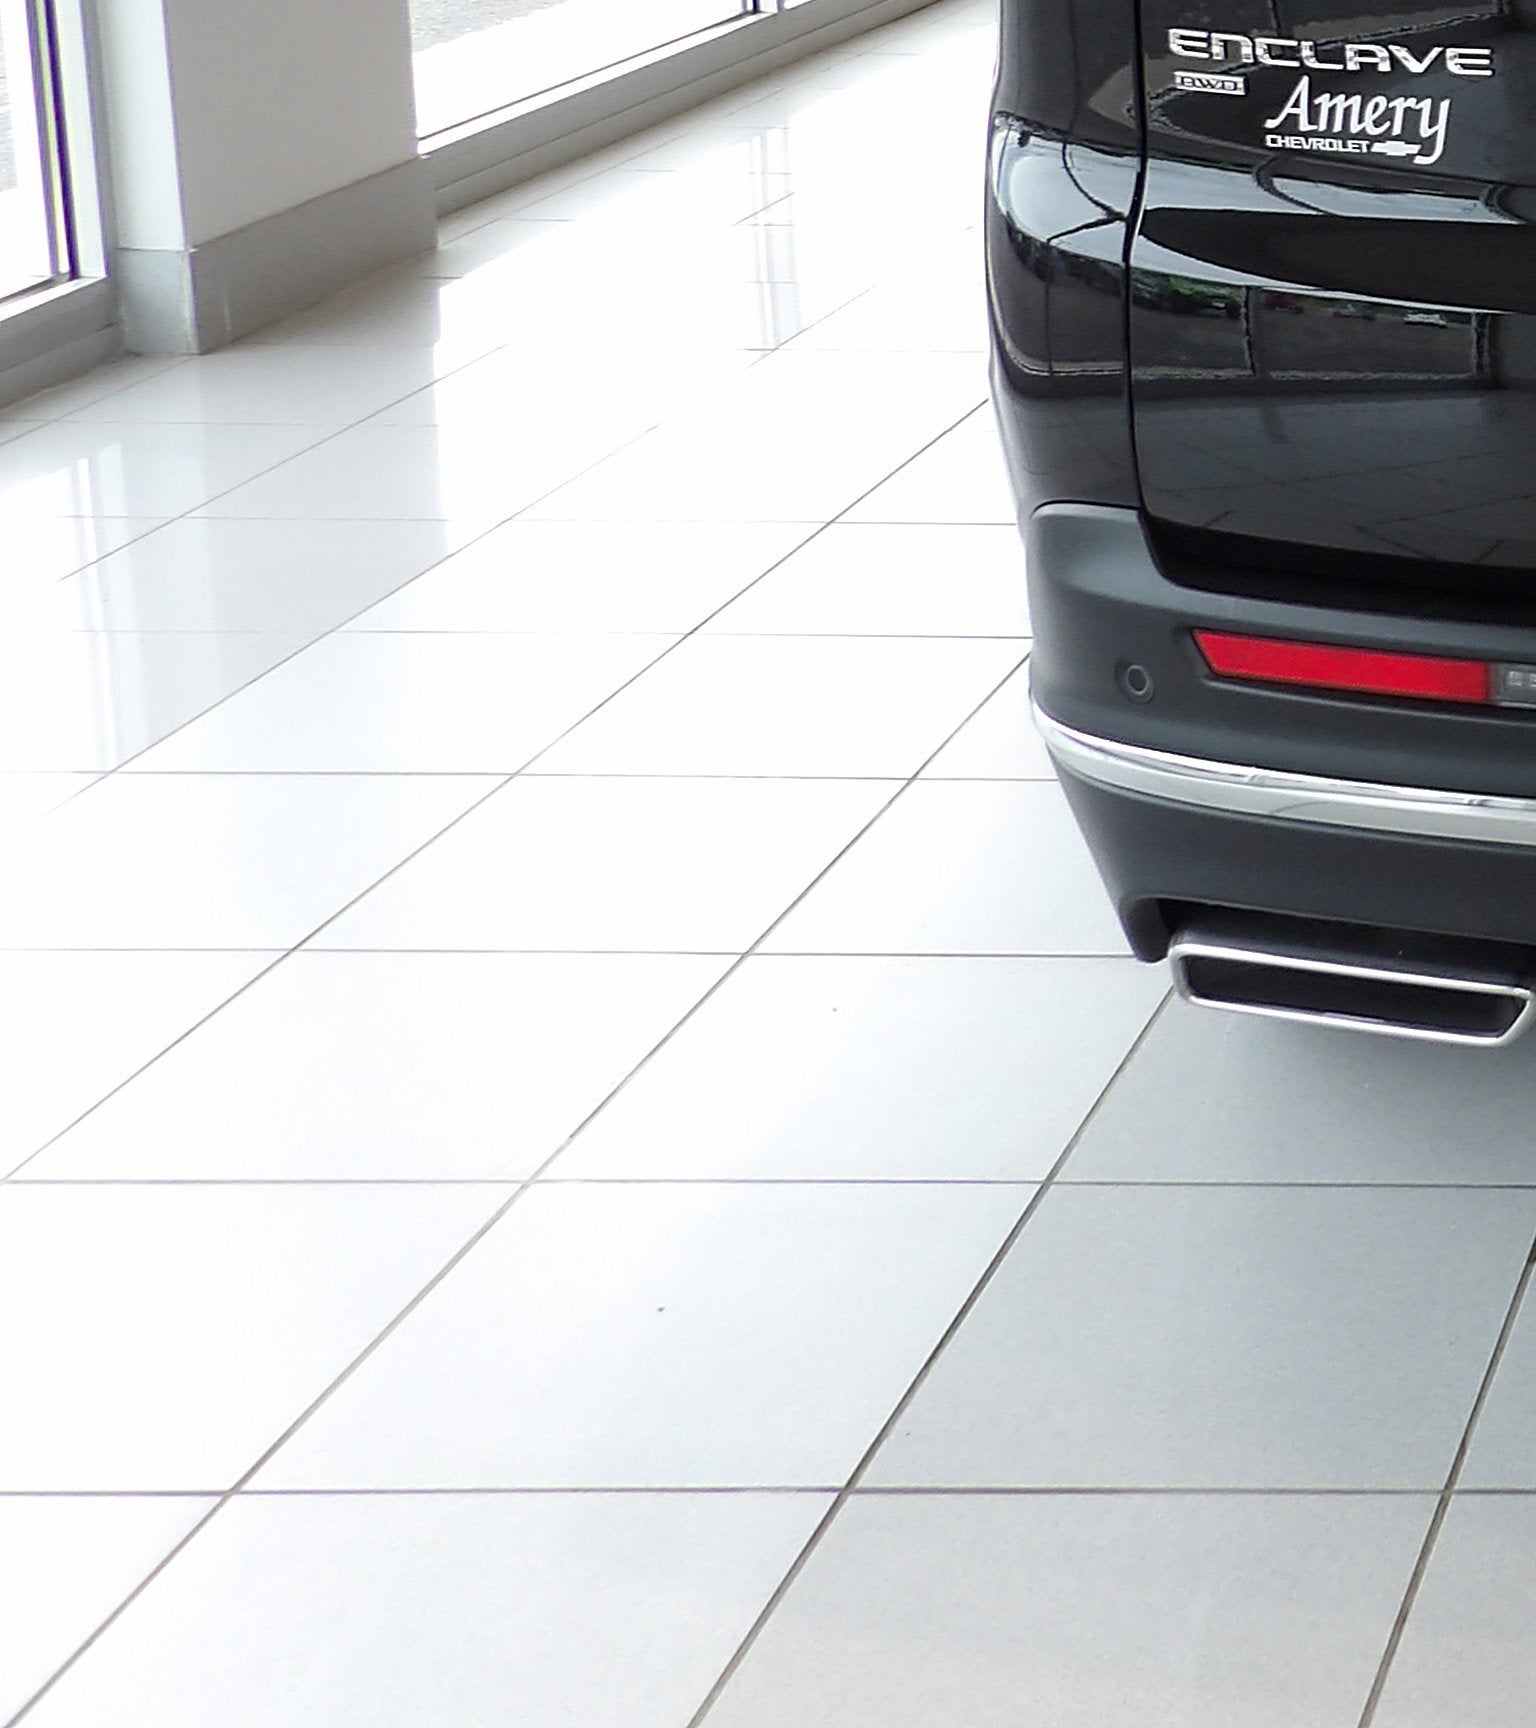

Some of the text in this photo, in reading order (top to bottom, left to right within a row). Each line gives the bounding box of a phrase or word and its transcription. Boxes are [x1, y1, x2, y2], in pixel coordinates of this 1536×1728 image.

[1167, 27, 1495, 76] ENCLAVE
[1264, 74, 1451, 165] Amery
[1265, 133, 1371, 154] CHEVROLET
